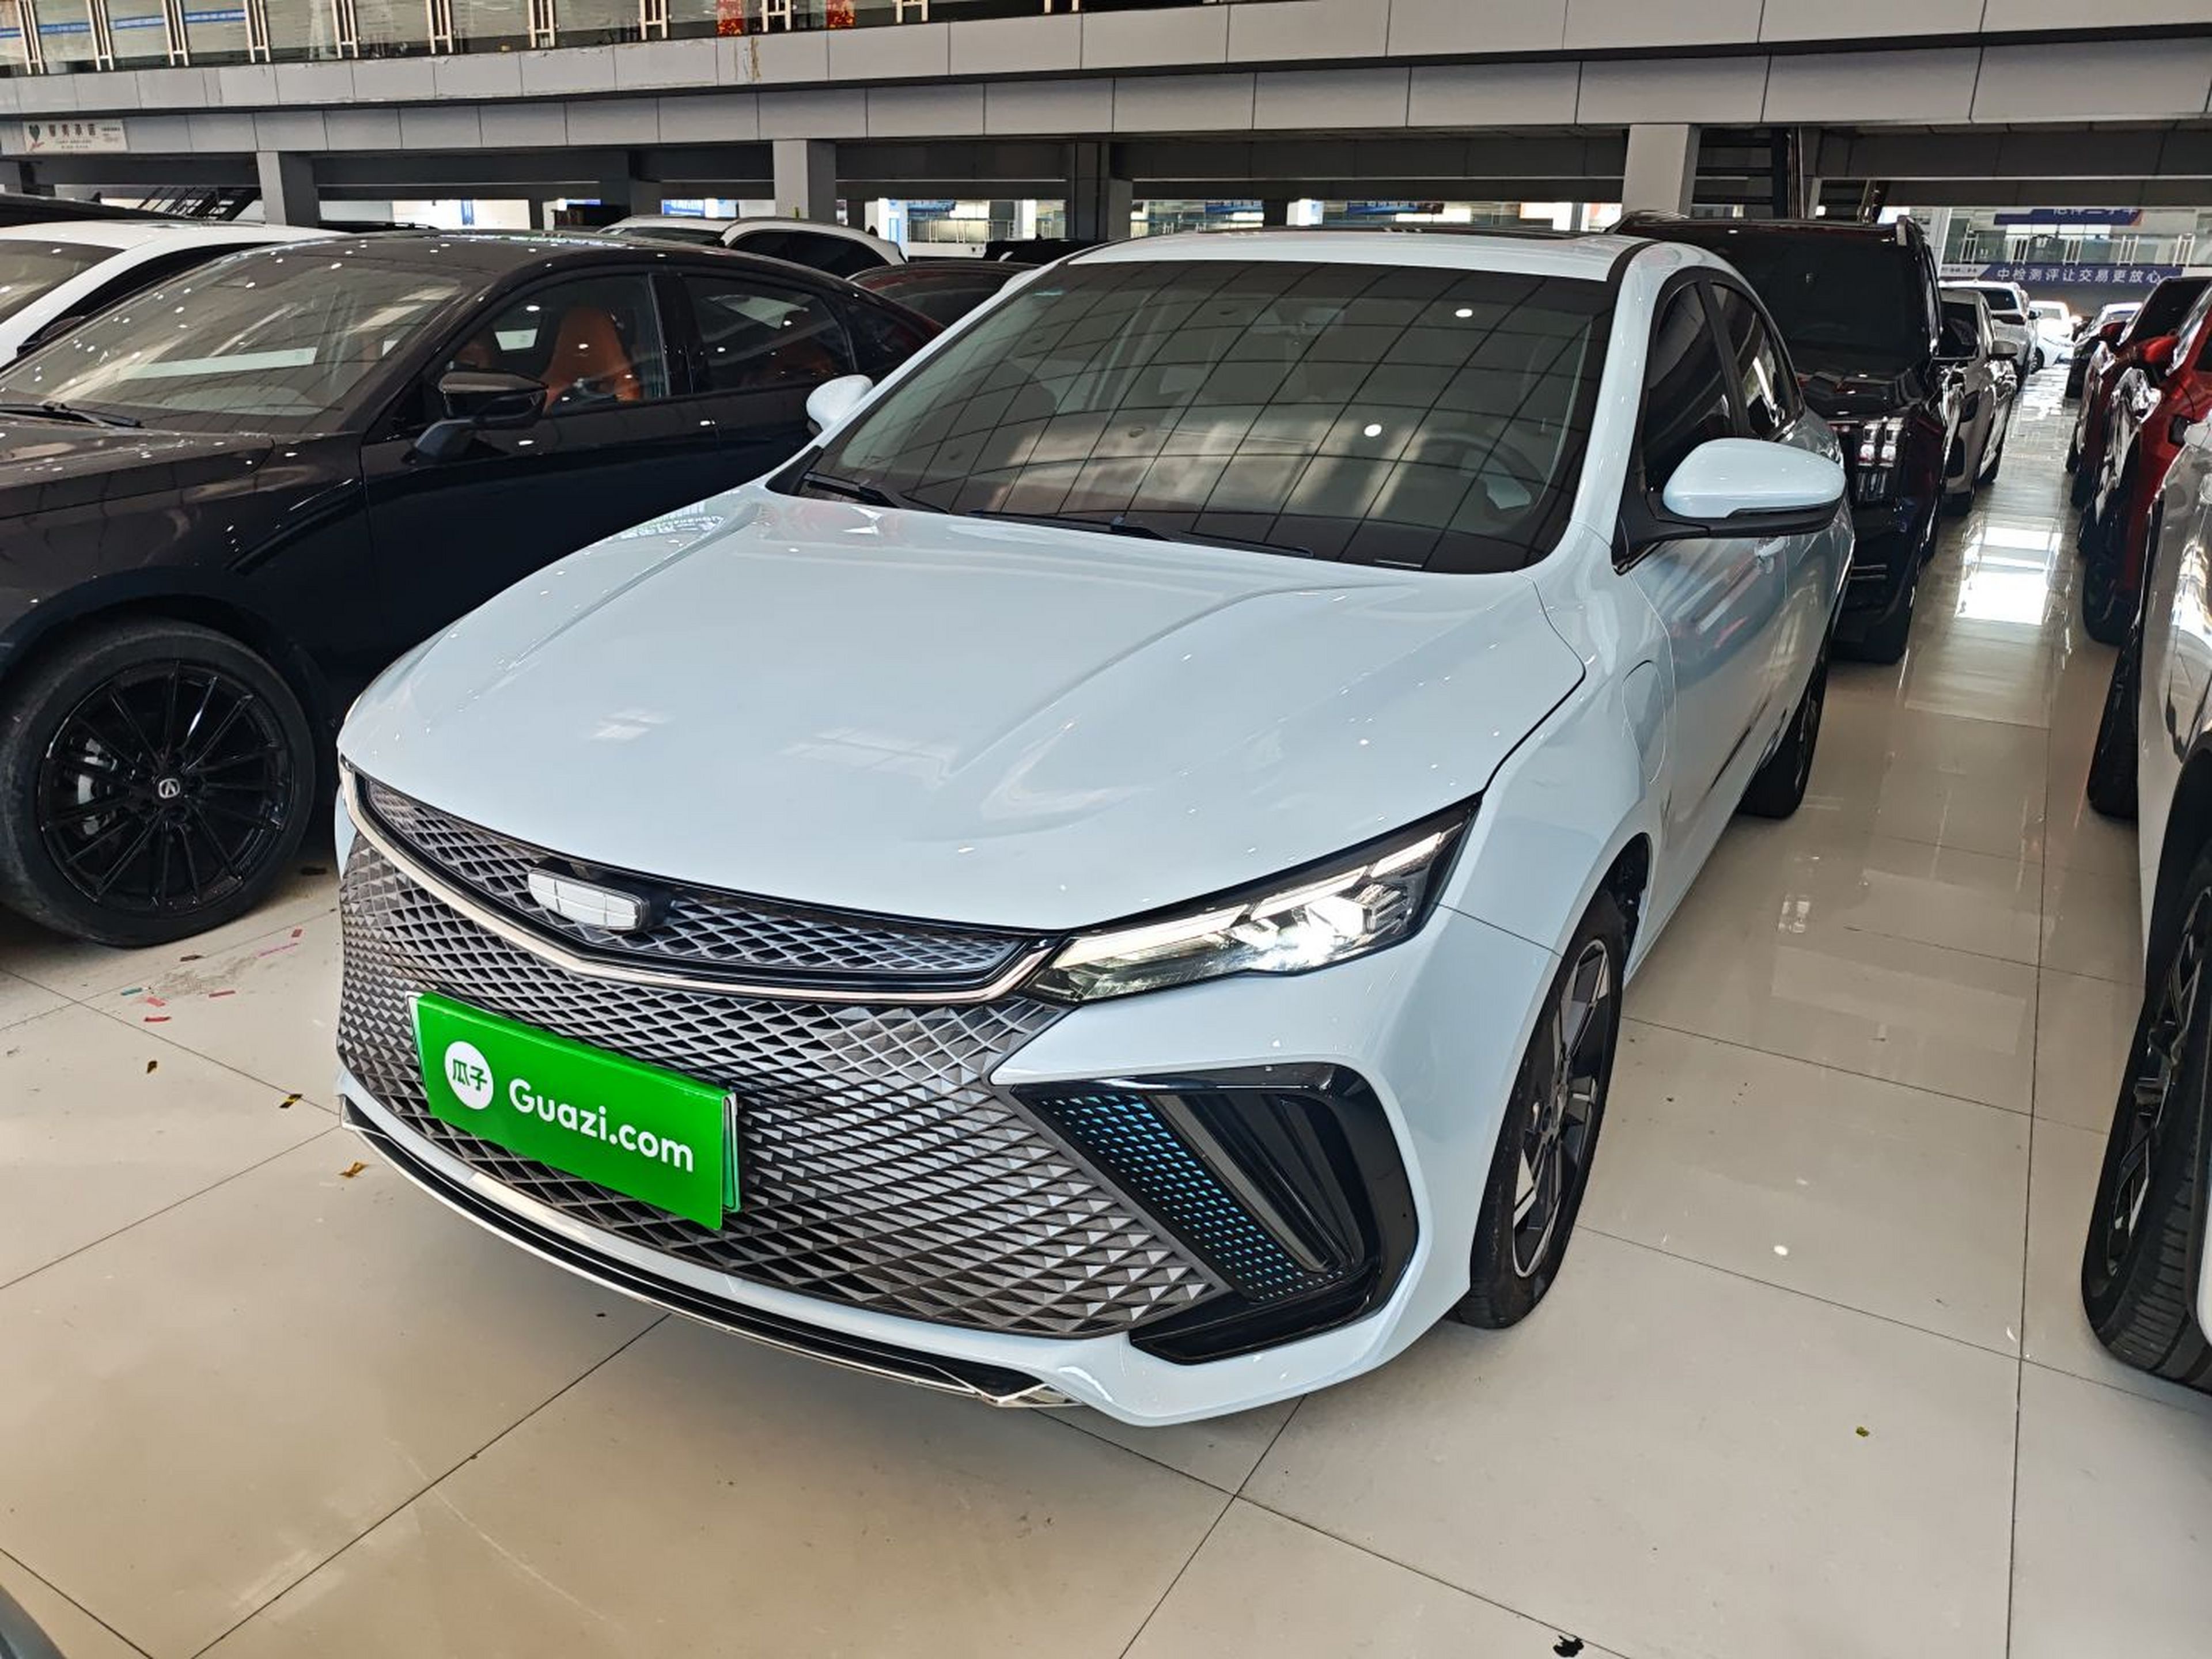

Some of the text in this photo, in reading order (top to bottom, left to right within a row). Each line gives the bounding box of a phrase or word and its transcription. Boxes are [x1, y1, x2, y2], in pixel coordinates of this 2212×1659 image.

[1997, 267, 2160, 284] 中检测评让交易更放心
[452, 1058, 487, 1091] 瓜子
[509, 1078, 694, 1173] Guazi.com
